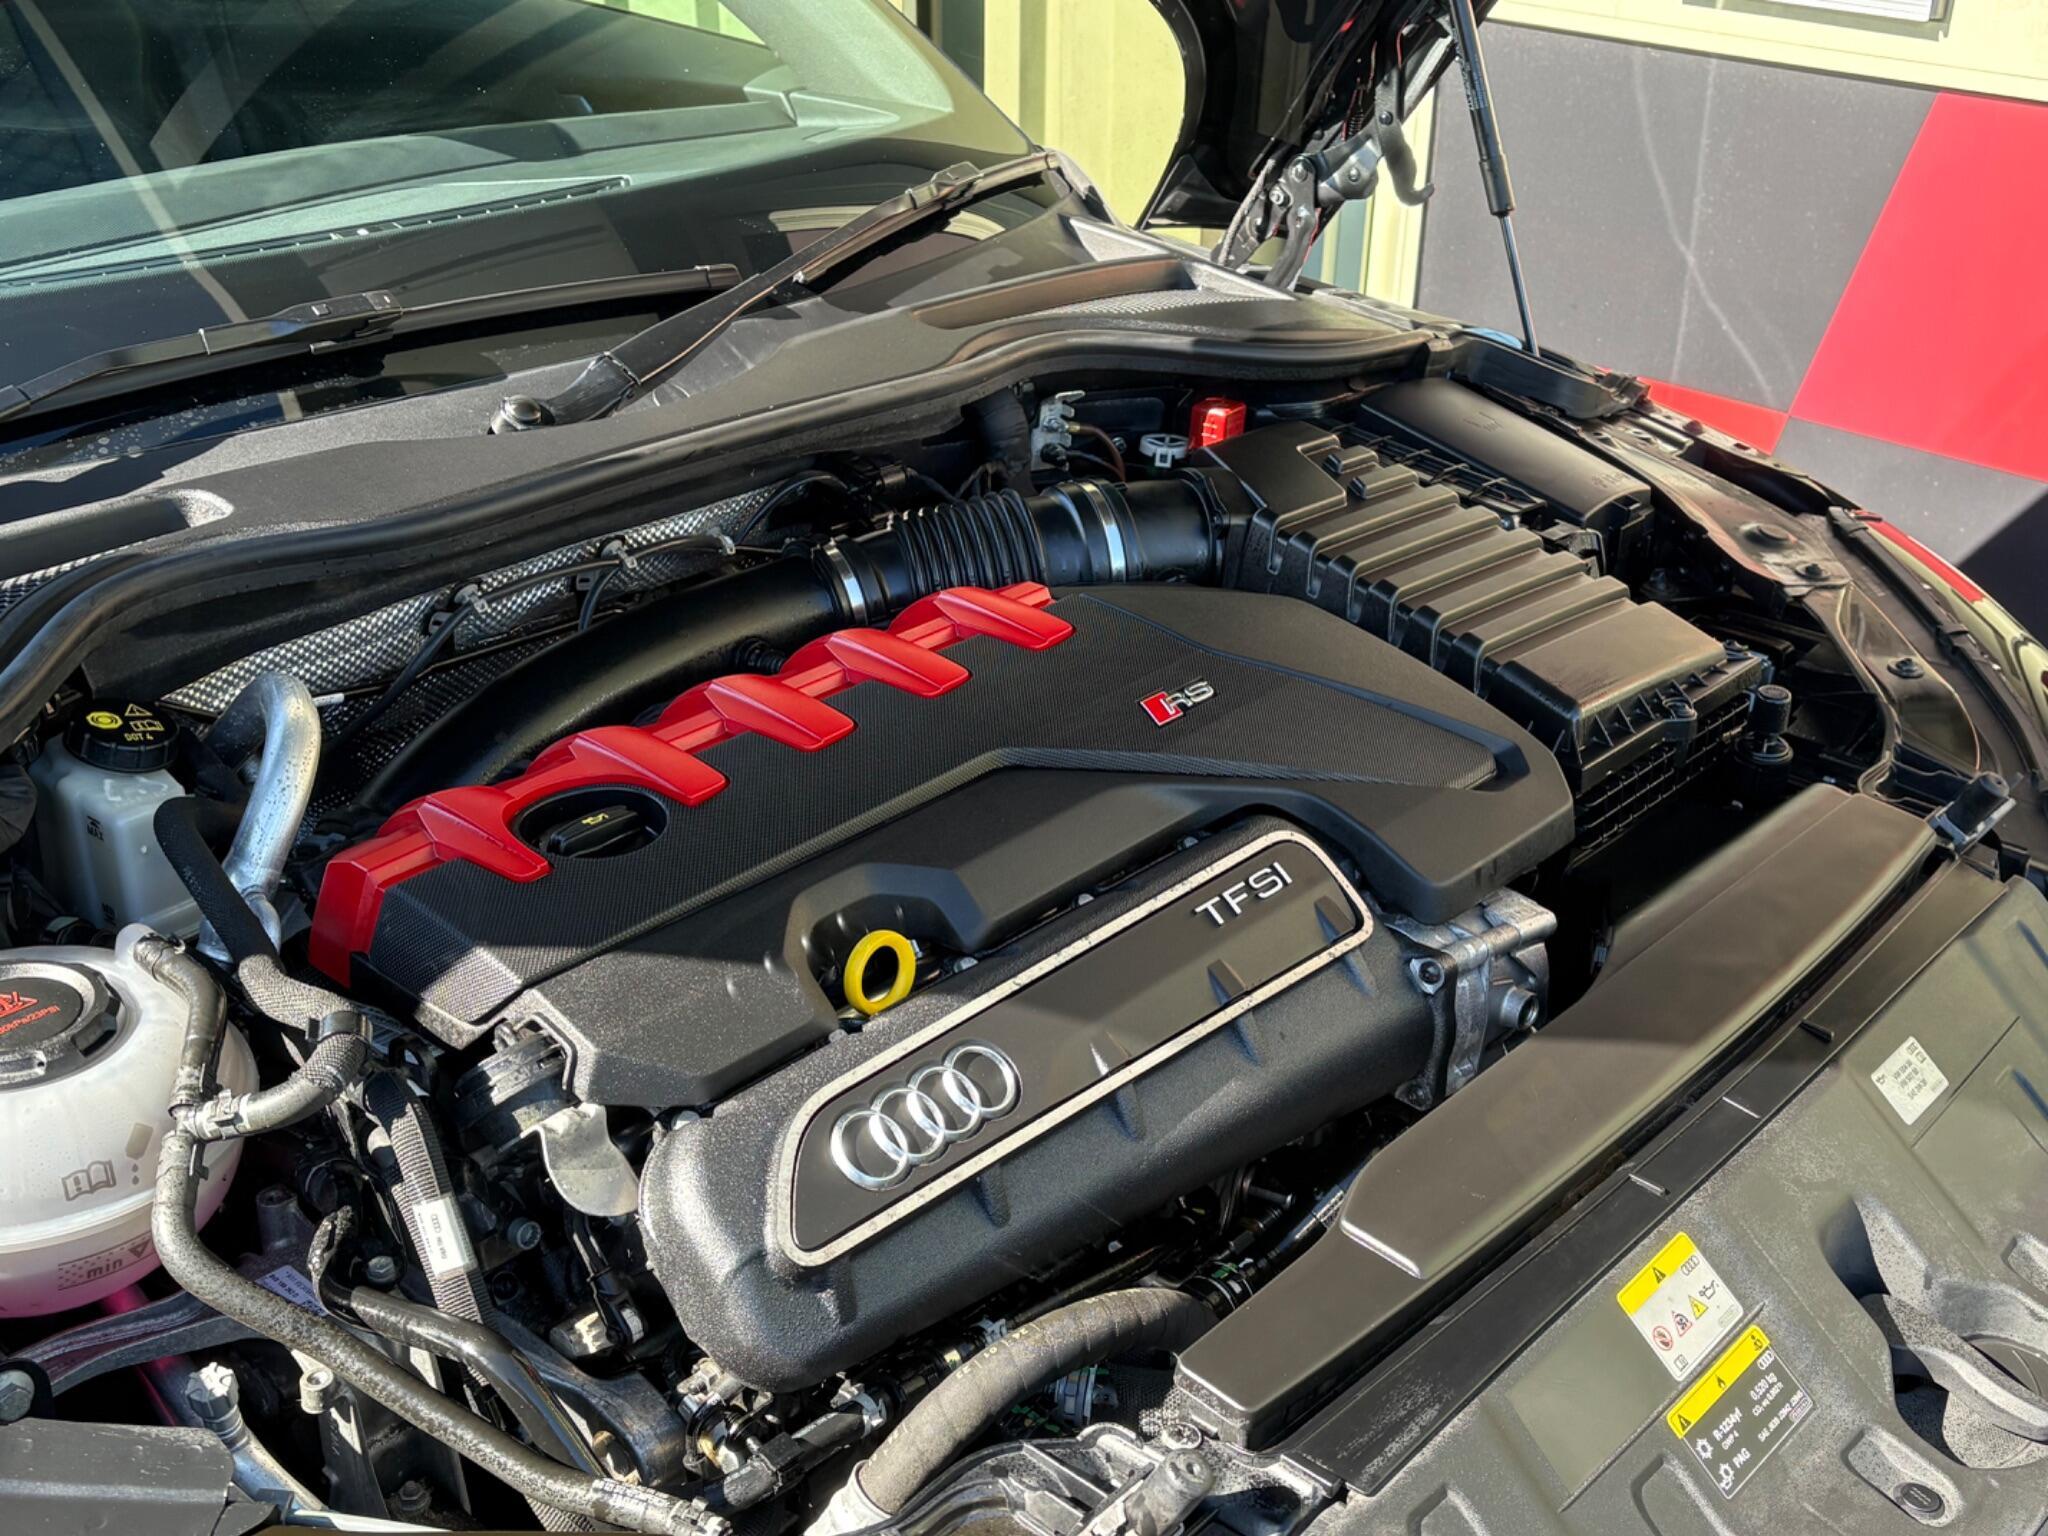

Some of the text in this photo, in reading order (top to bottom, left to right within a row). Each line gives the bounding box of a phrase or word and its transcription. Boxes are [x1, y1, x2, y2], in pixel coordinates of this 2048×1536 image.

[1158, 680, 1215, 717] RS
[124, 732, 154, 741] DOT 4
[1194, 861, 1293, 926] TFSI
[87, 1257, 123, 1279] min
[1750, 1372, 1777, 1400] 0,520 kg
[1712, 1407, 1743, 1441] R-1234yf
[1733, 1448, 1751, 1468] PAG
